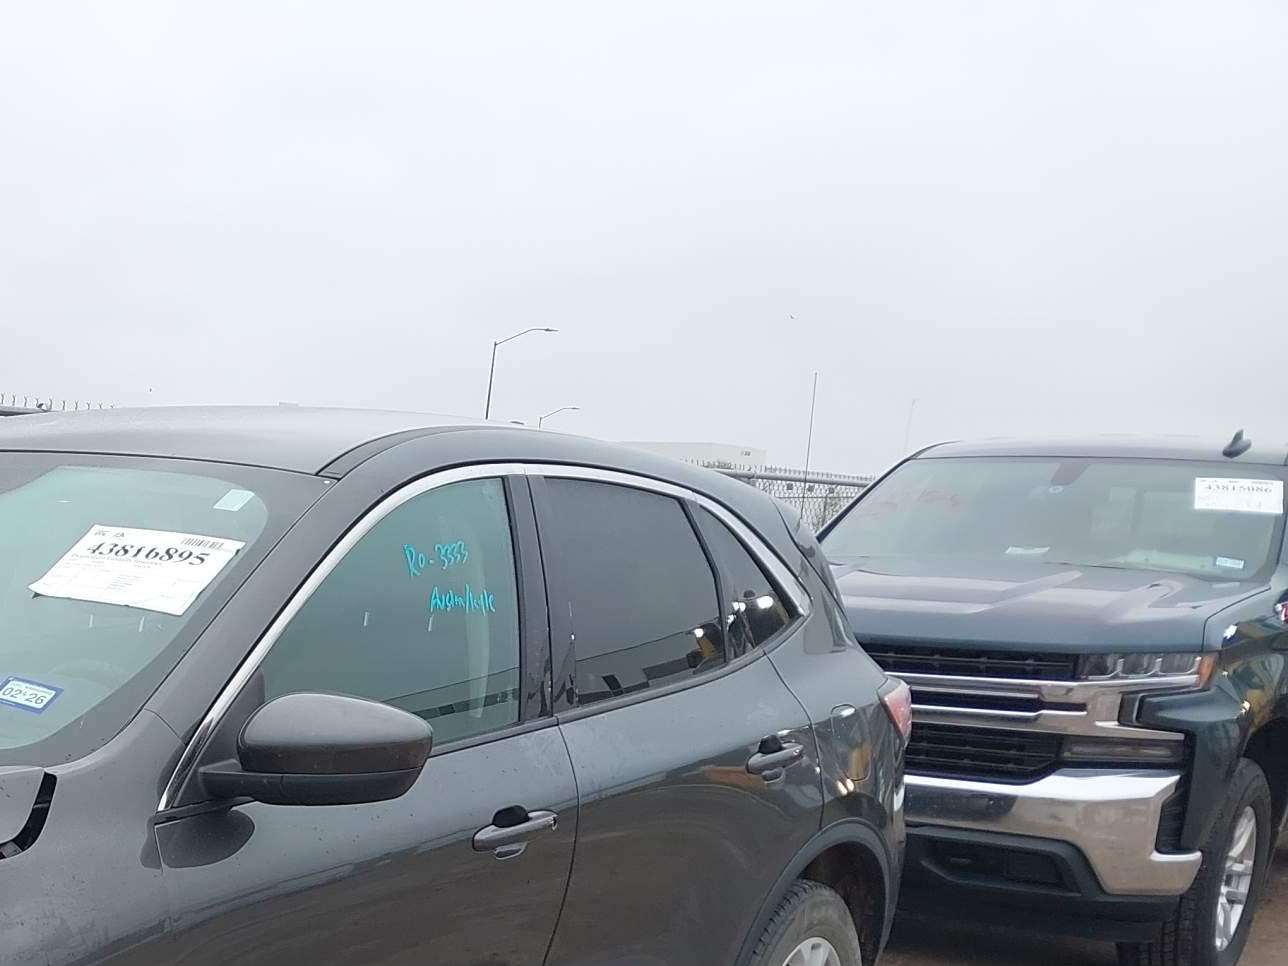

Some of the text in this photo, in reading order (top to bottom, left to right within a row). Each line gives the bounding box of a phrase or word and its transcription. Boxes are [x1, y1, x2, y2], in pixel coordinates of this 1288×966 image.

[87, 541, 212, 567] 43816895
[2, 687, 23, 700] 02
[24, 692, 47, 705] 26
